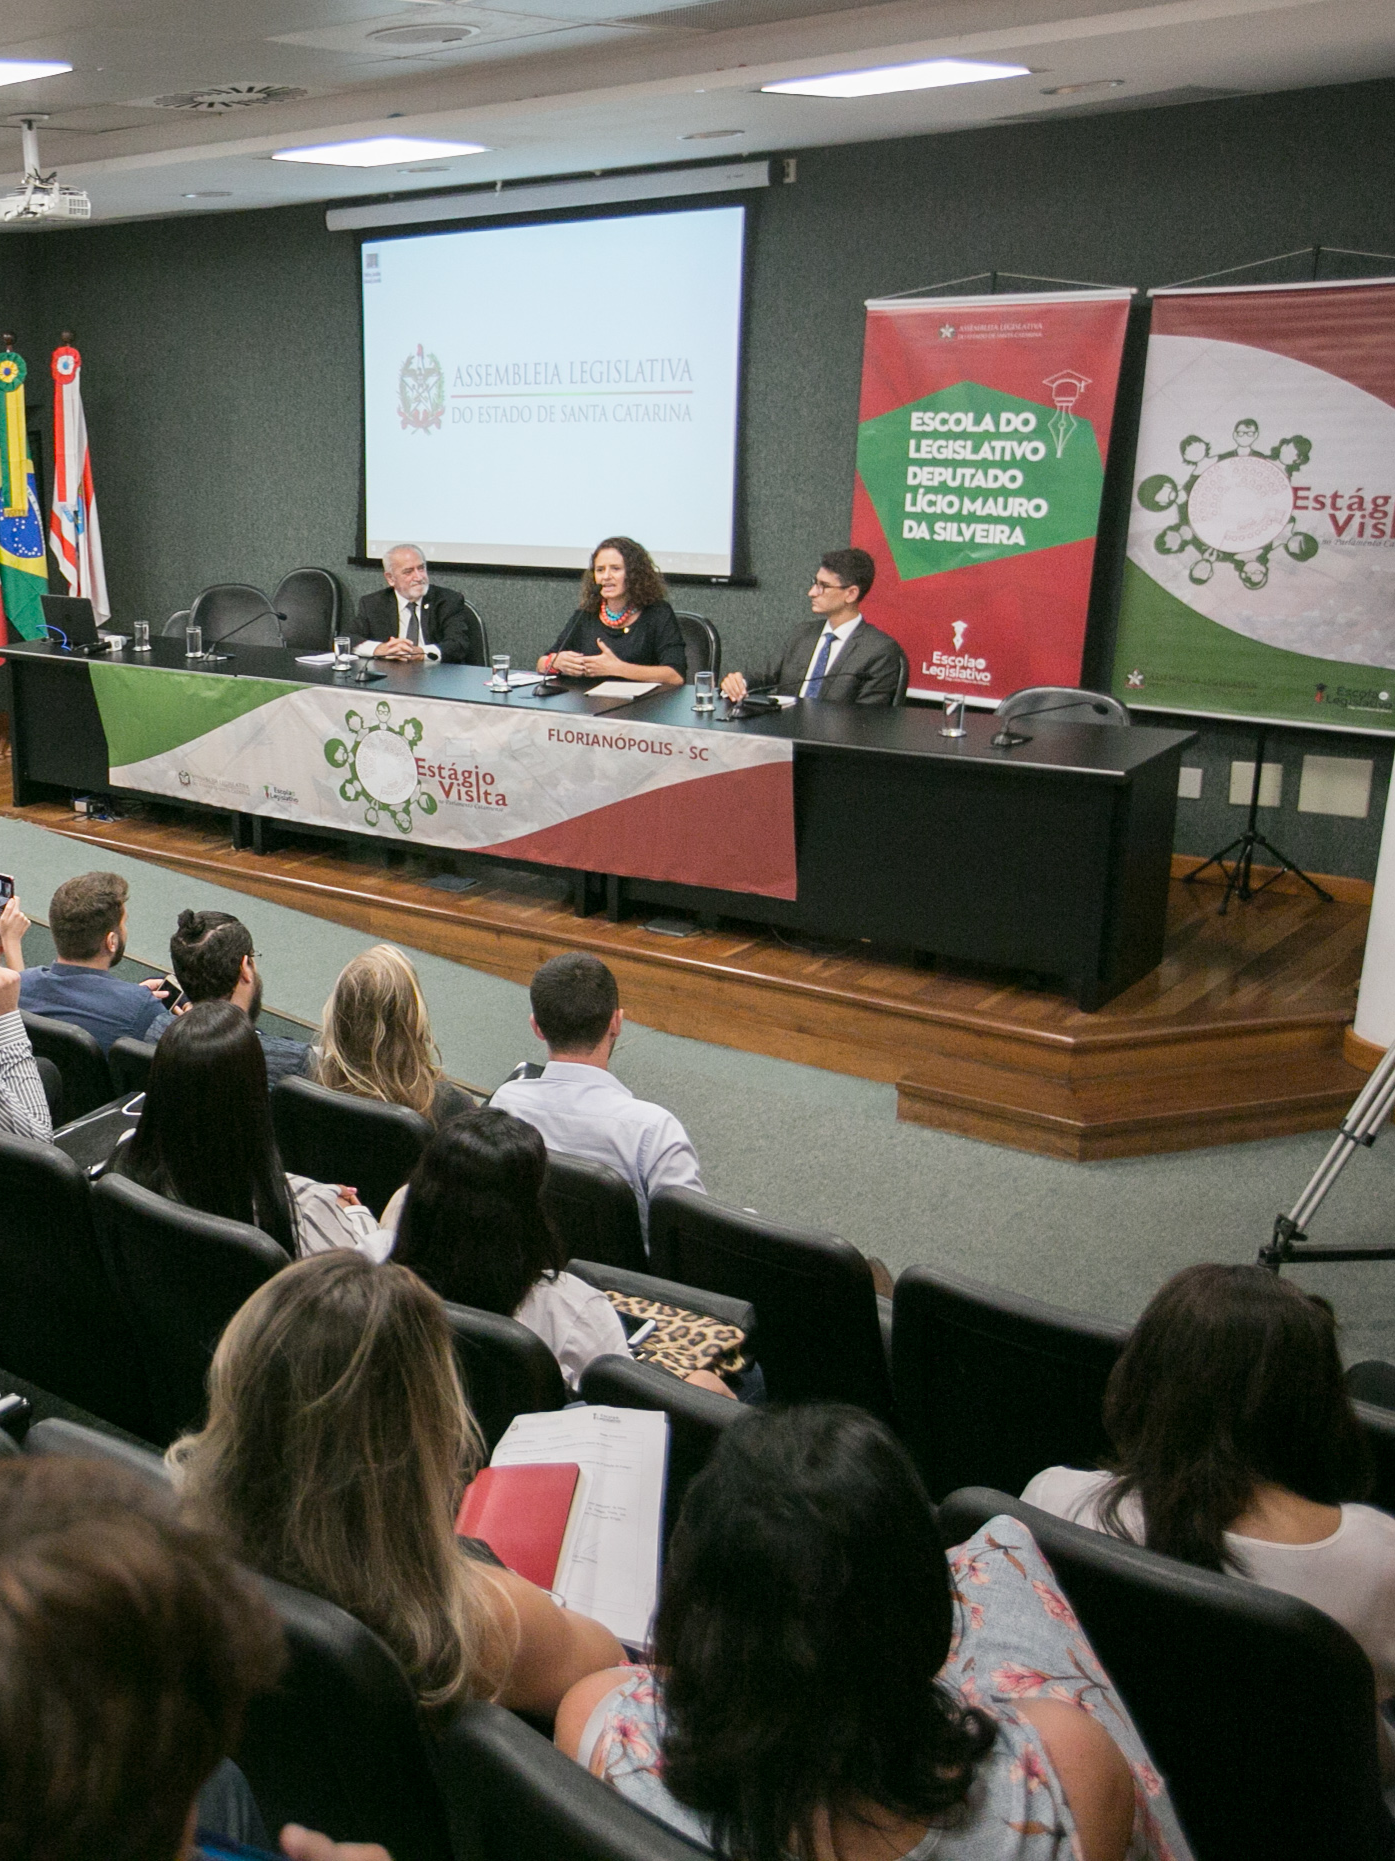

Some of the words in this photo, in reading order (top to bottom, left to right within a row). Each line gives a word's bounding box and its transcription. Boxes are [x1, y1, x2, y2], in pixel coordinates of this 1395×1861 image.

[453, 362, 562, 387] ASSEMBLEIA
[569, 358, 693, 384] LEGISLATIVA
[451, 406, 473, 424] DO
[478, 405, 532, 423] ESTADO
[537, 405, 556, 423] DE
[560, 404, 606, 423] SANTA
[612, 403, 692, 423] CATARINA
[910, 411, 996, 433] ESCOLA
[999, 412, 1037, 433] DO
[908, 439, 1046, 462] LEGISLATIVO
[906, 466, 1024, 489] DEPUTADO
[904, 488, 960, 515] LÍCIO
[961, 495, 1049, 519] MAURO
[902, 519, 931, 540] DA
[932, 521, 1026, 546] SILVEIRA
[932, 651, 976, 668] Escola
[922, 661, 992, 682] Legislativo
[1336, 686, 1378, 698] Escola
[547, 728, 673, 756] FLORIANÓPOLIS
[689, 746, 709, 761] SC
[414, 757, 495, 789] Estágio
[437, 779, 508, 807] Visita
